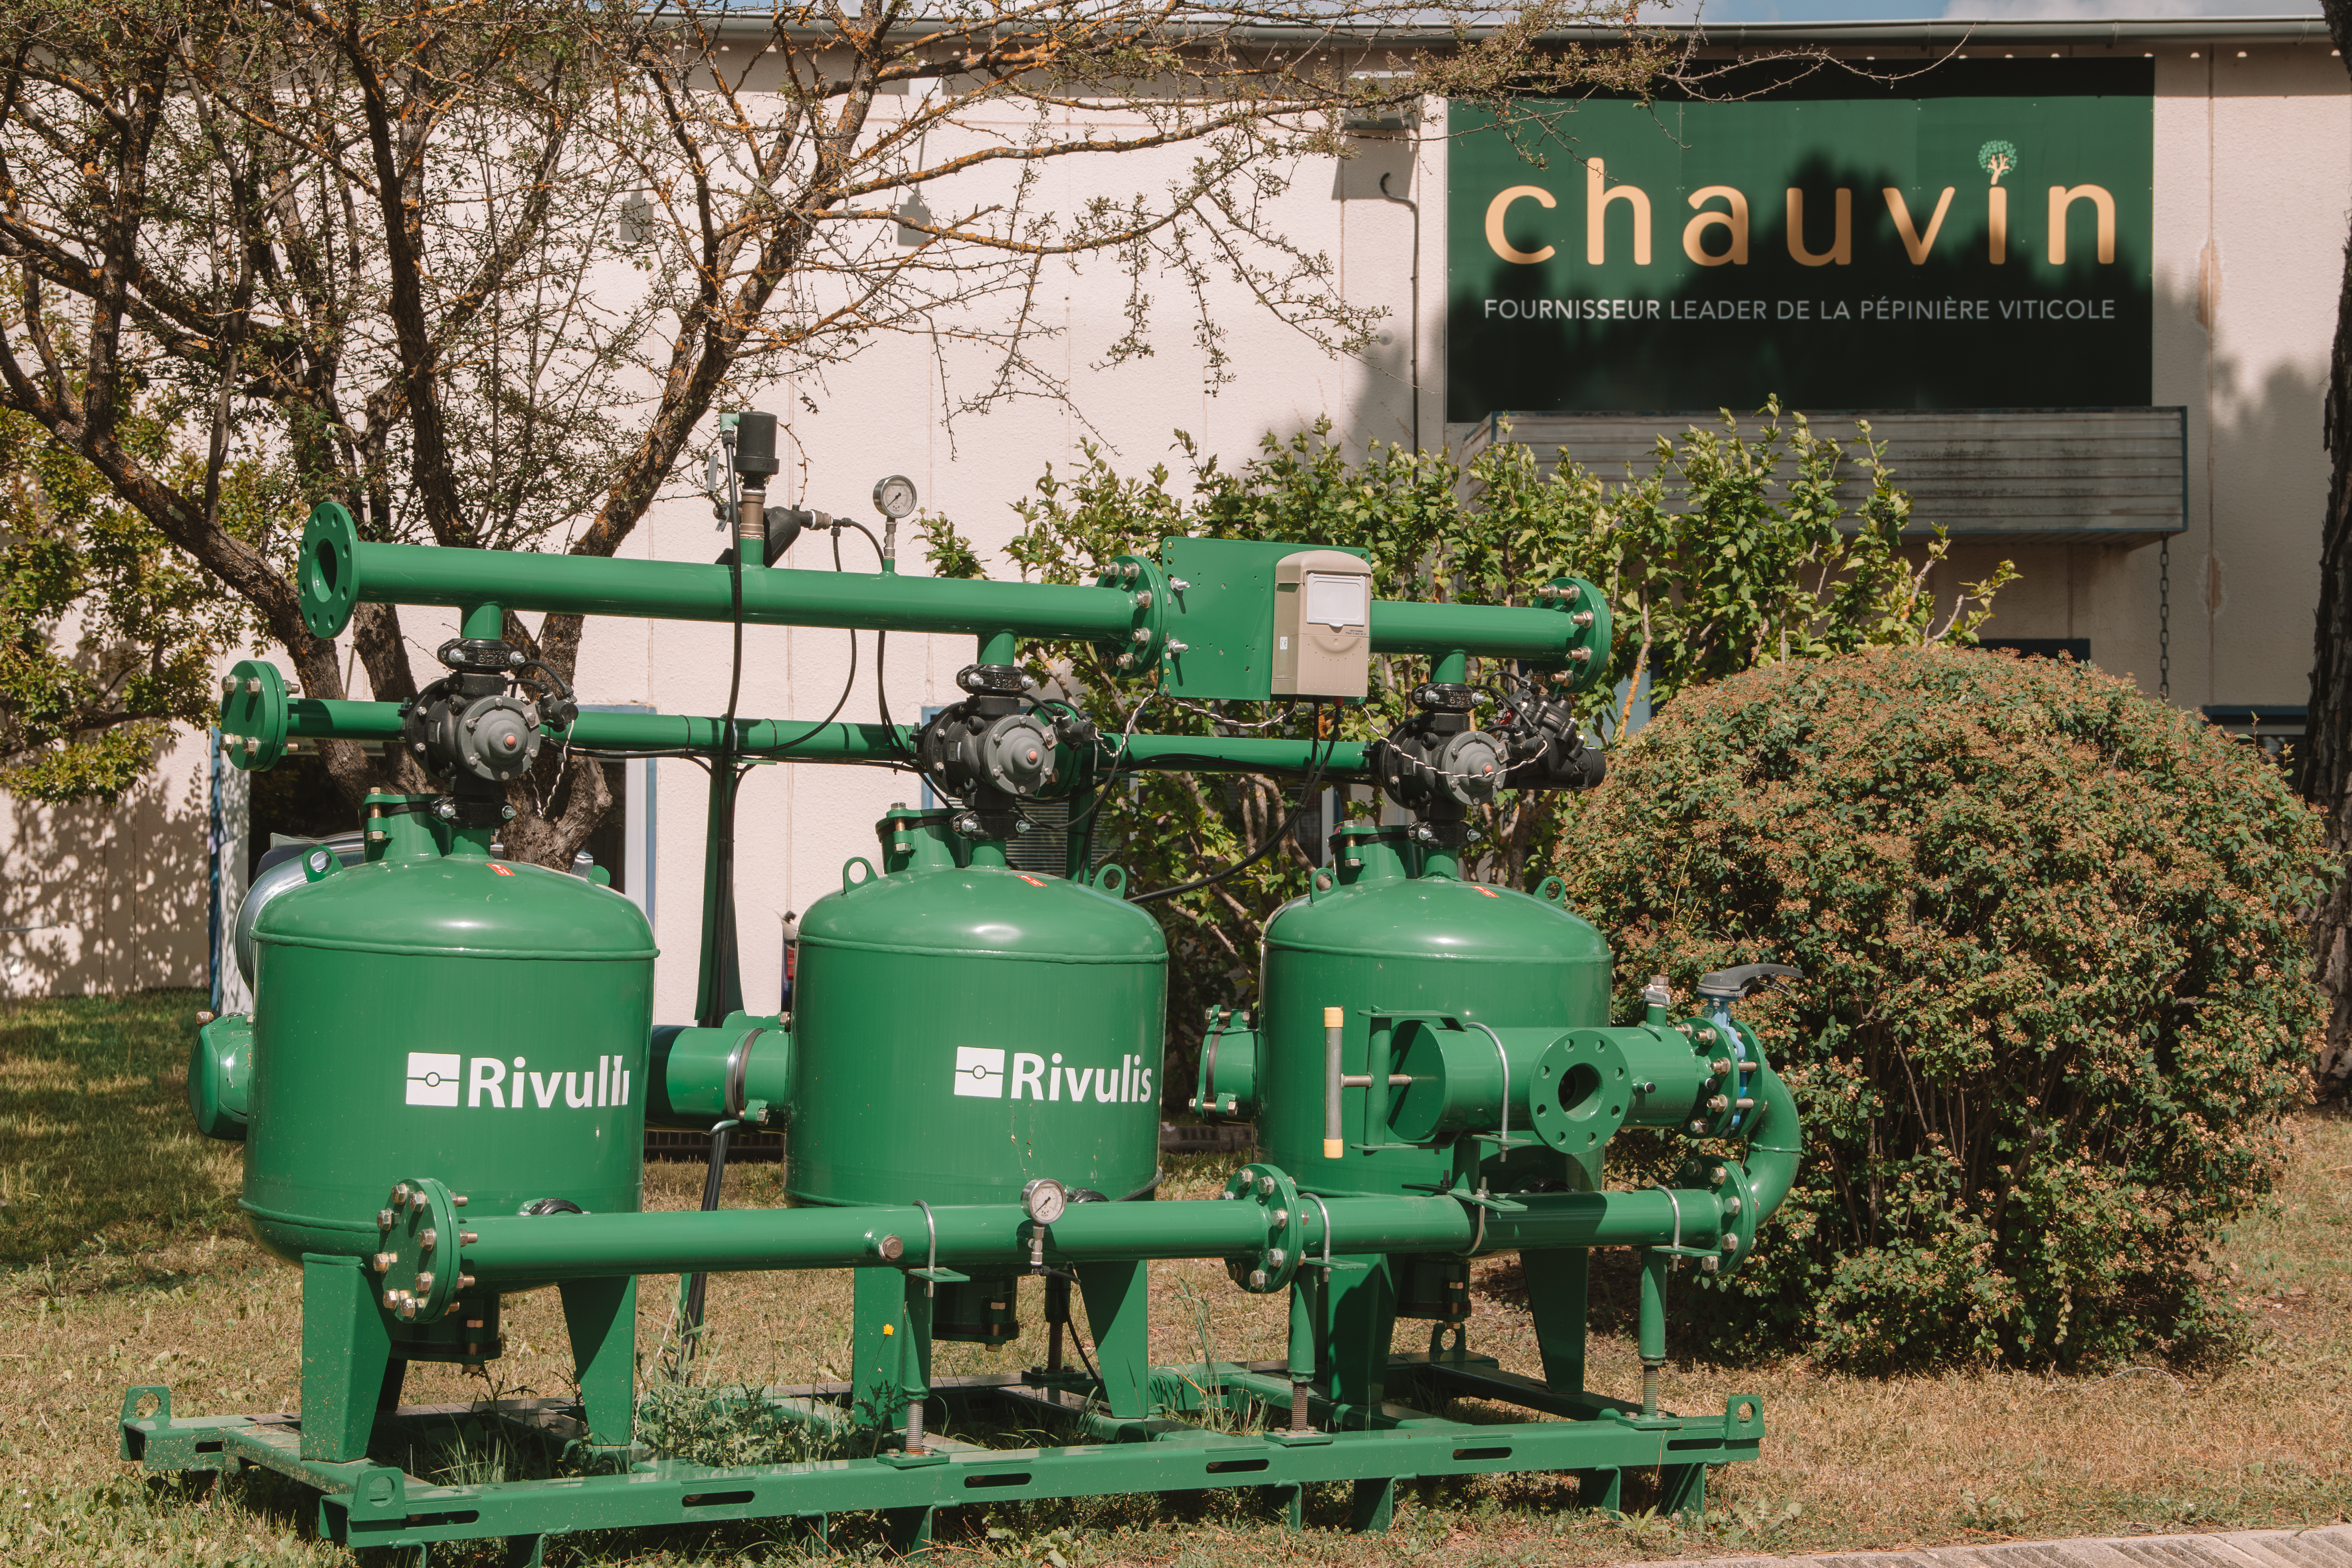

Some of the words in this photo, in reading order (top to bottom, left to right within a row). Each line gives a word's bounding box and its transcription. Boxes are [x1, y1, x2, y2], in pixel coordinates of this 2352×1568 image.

[1484, 141, 2116, 266] chauvin
[1484, 298, 1661, 319] FOURNISSEUR
[1670, 299, 1766, 319] LEADER
[1778, 300, 1810, 319] DE
[1821, 300, 1851, 319] LA
[1861, 295, 1990, 319] PÉPINIÈRE
[1999, 299, 2115, 319] VITICOLE
[1011, 1052, 1152, 1102] Rivulis
